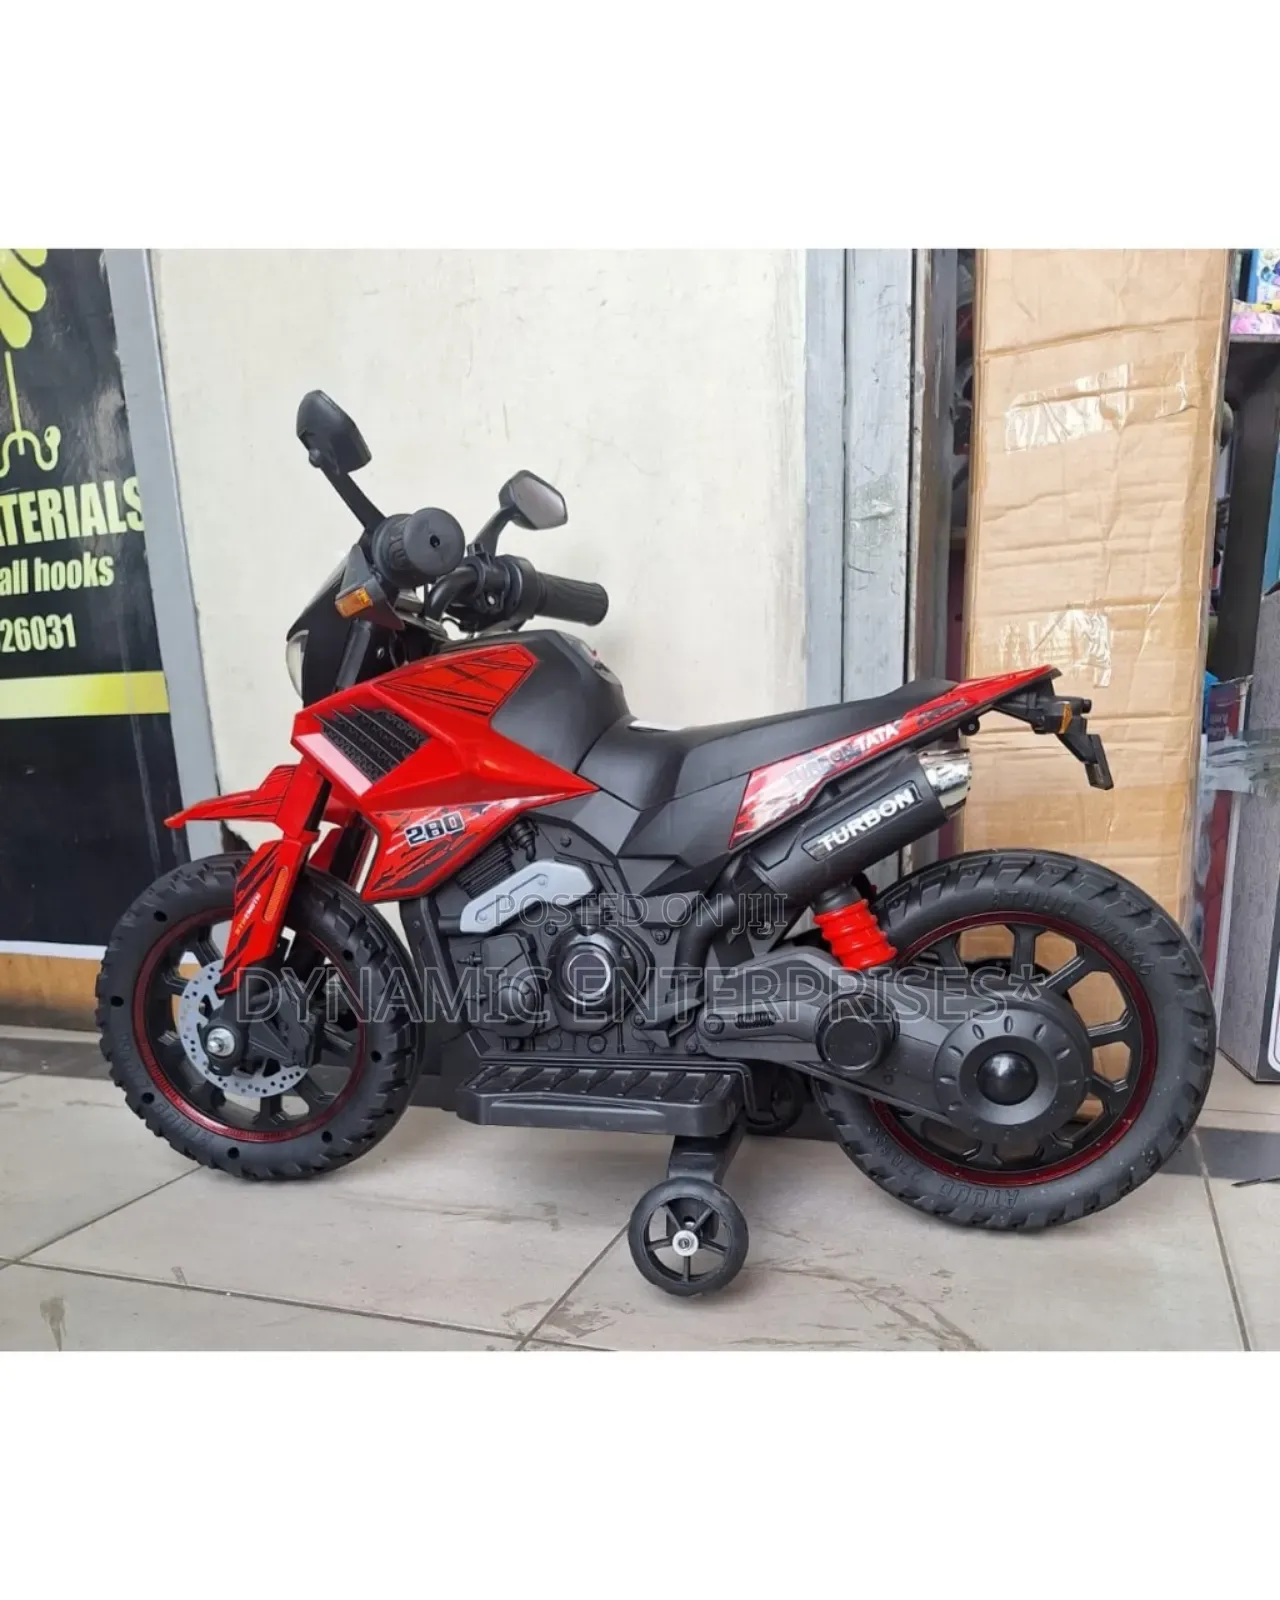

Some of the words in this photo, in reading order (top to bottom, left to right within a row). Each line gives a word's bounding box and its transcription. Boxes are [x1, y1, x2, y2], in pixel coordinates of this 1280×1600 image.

[34, 551, 114, 592] hooks
[0, 613, 76, 653] 26031
[404, 811, 465, 847] 280
[816, 787, 915, 851] TURBON
